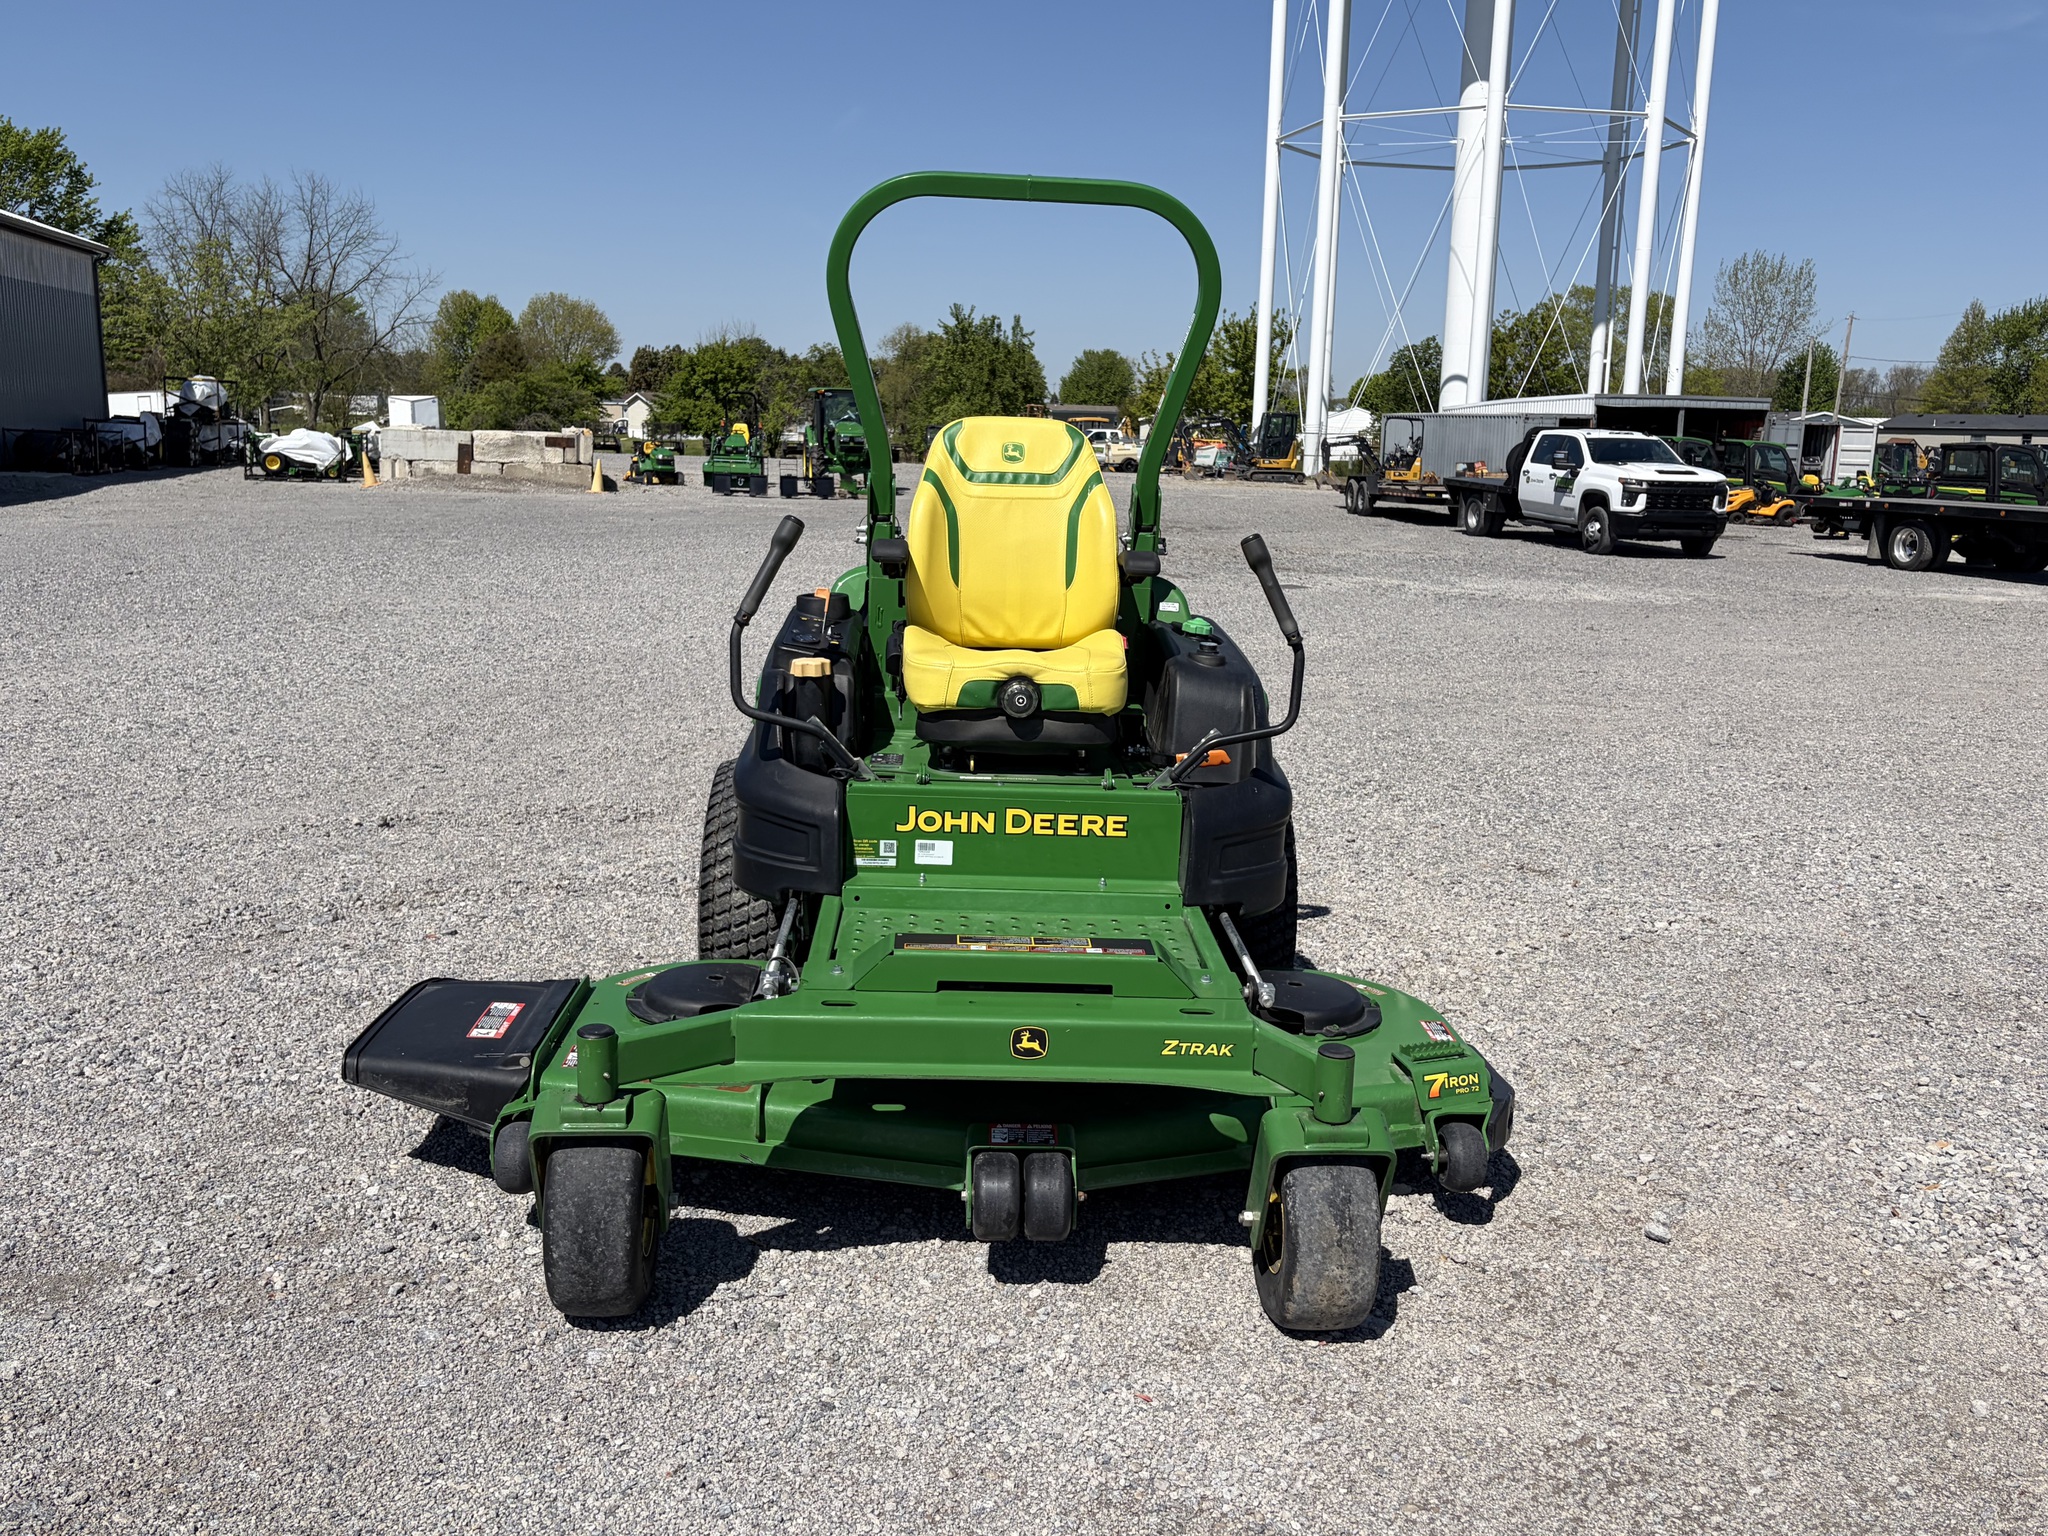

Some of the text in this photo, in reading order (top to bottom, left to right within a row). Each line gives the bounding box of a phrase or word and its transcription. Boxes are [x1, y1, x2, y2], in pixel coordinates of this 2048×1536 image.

[895, 805, 1128, 838] JOHN DEERE
[1161, 1039, 1234, 1057] ZTRAK
